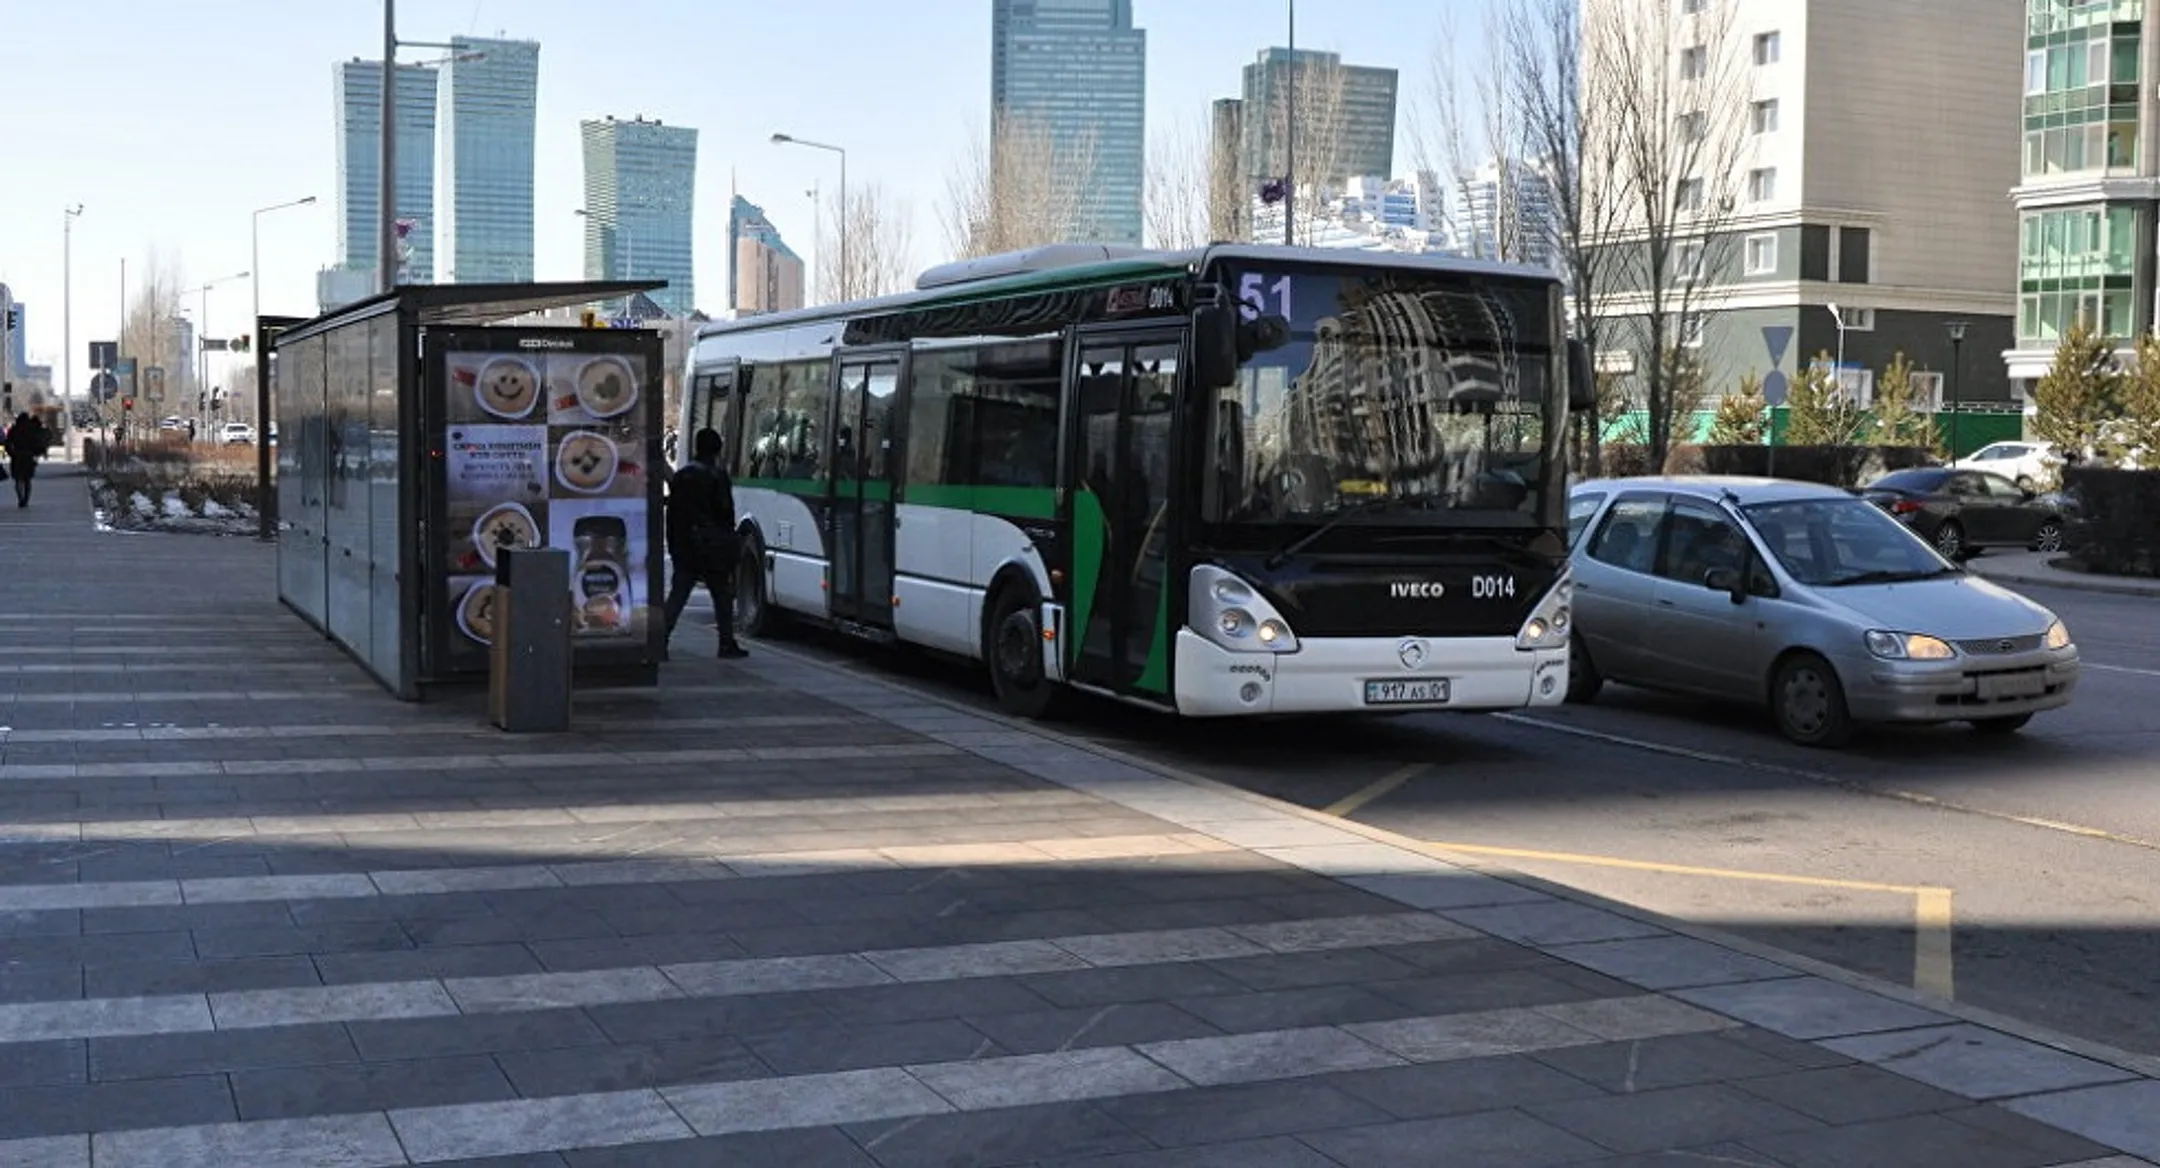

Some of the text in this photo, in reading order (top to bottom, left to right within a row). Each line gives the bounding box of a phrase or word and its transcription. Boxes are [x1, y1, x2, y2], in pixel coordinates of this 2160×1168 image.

[1240, 273, 1291, 322] 51
[1390, 582, 1444, 598] IVECO
[1472, 575, 1515, 597] D014
